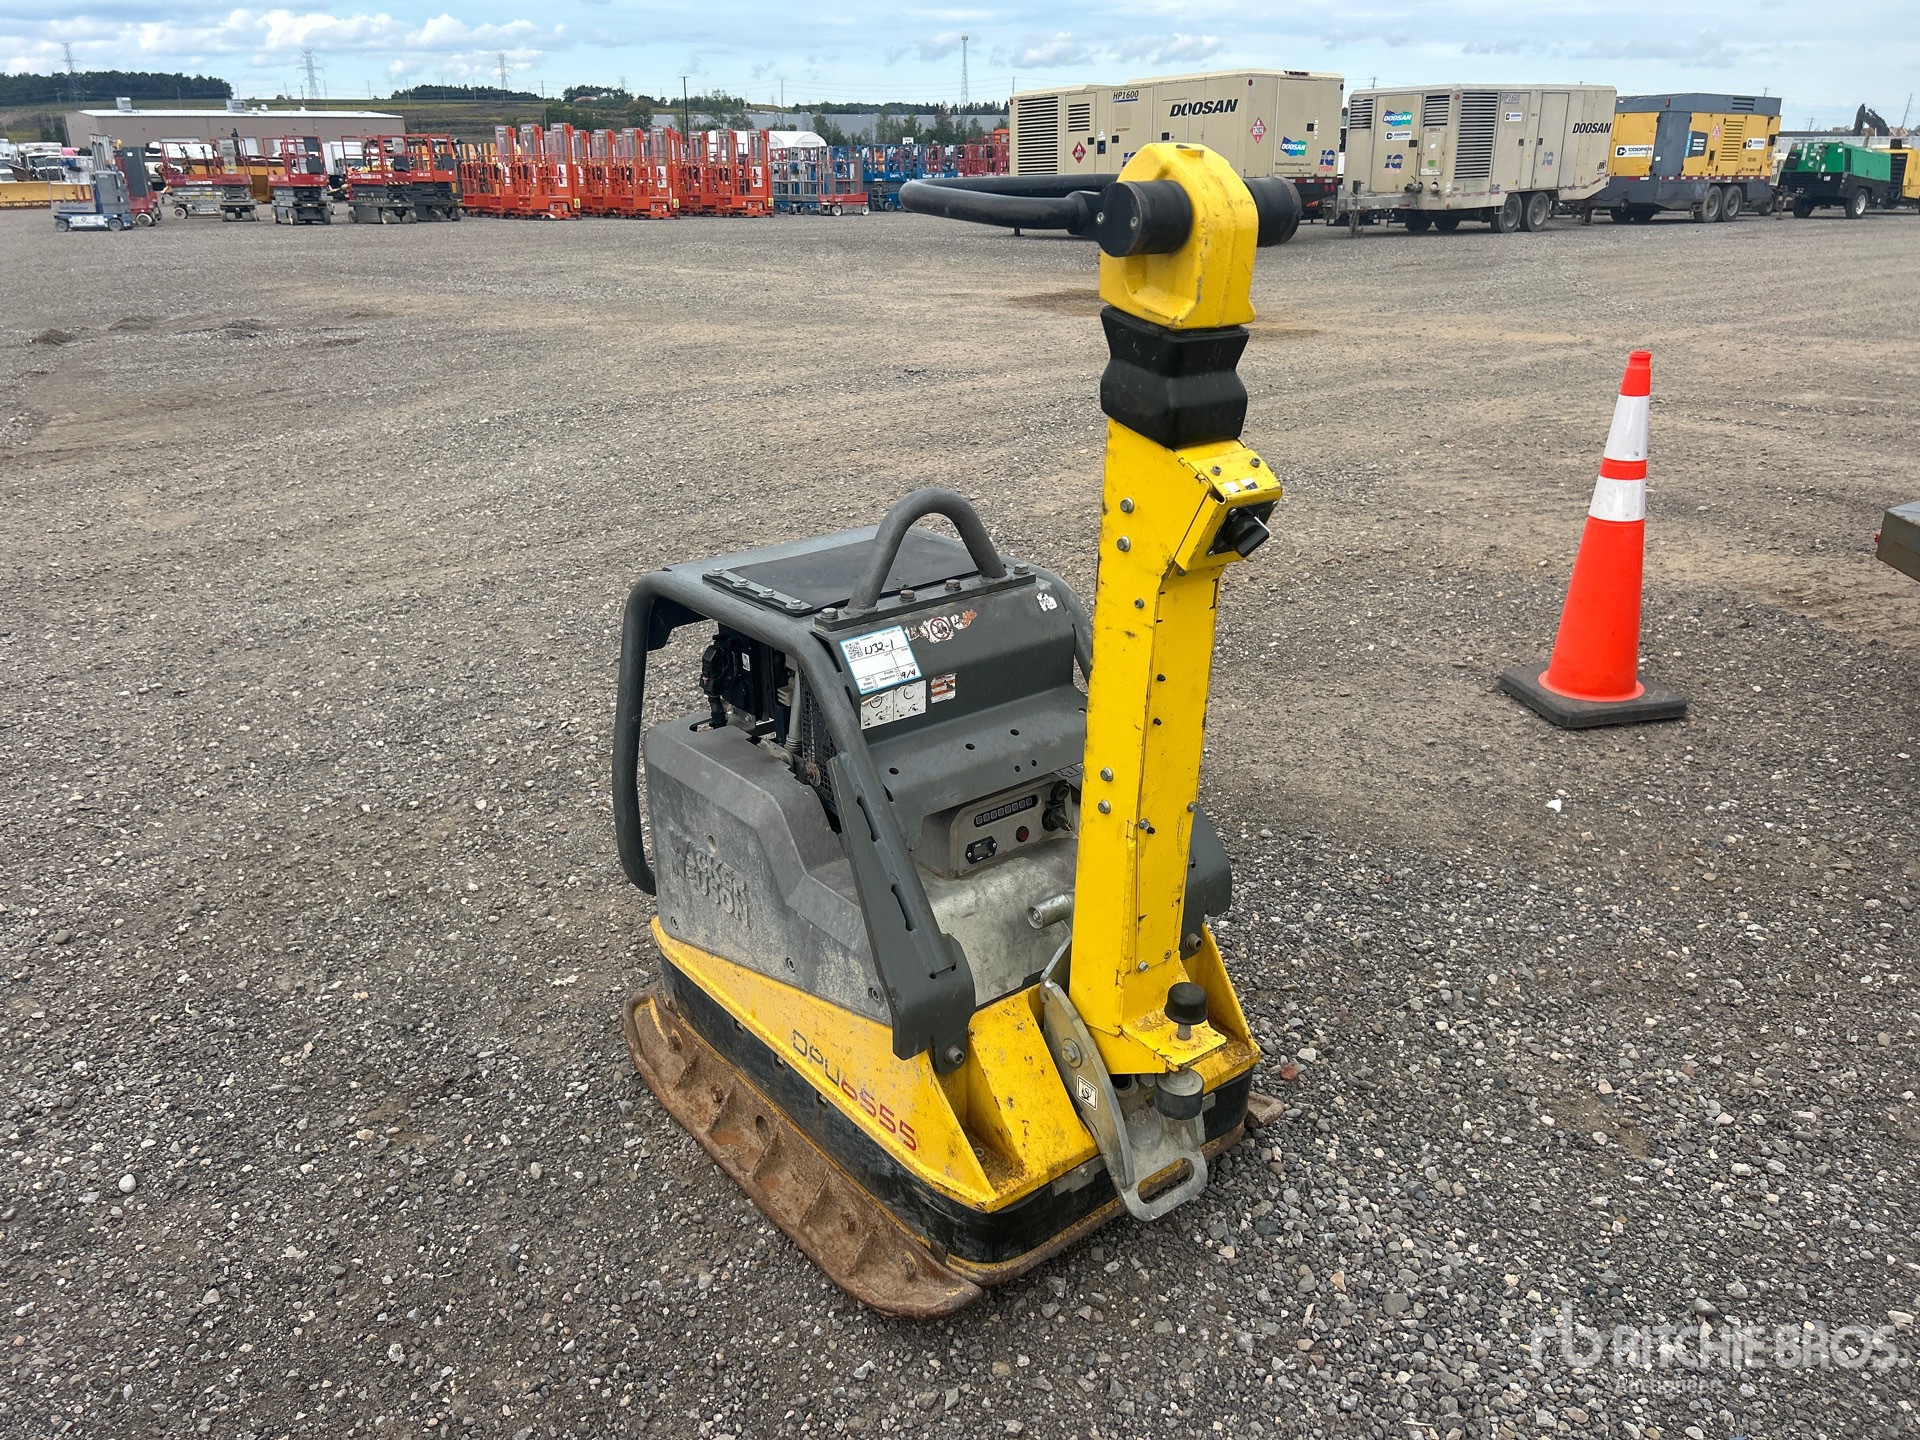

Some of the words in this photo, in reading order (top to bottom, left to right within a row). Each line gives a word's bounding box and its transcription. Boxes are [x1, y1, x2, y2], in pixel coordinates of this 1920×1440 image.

[1113, 90, 1139, 100] HP1600
[1169, 99, 1239, 117] DOOSAN
[1572, 123, 1612, 133] DOOSAN
[1281, 143, 1306, 151] DOOSAN
[1319, 150, 1335, 166] IQ
[1384, 154, 1403, 169] IQ
[791, 1029, 917, 1152] DPU6555
